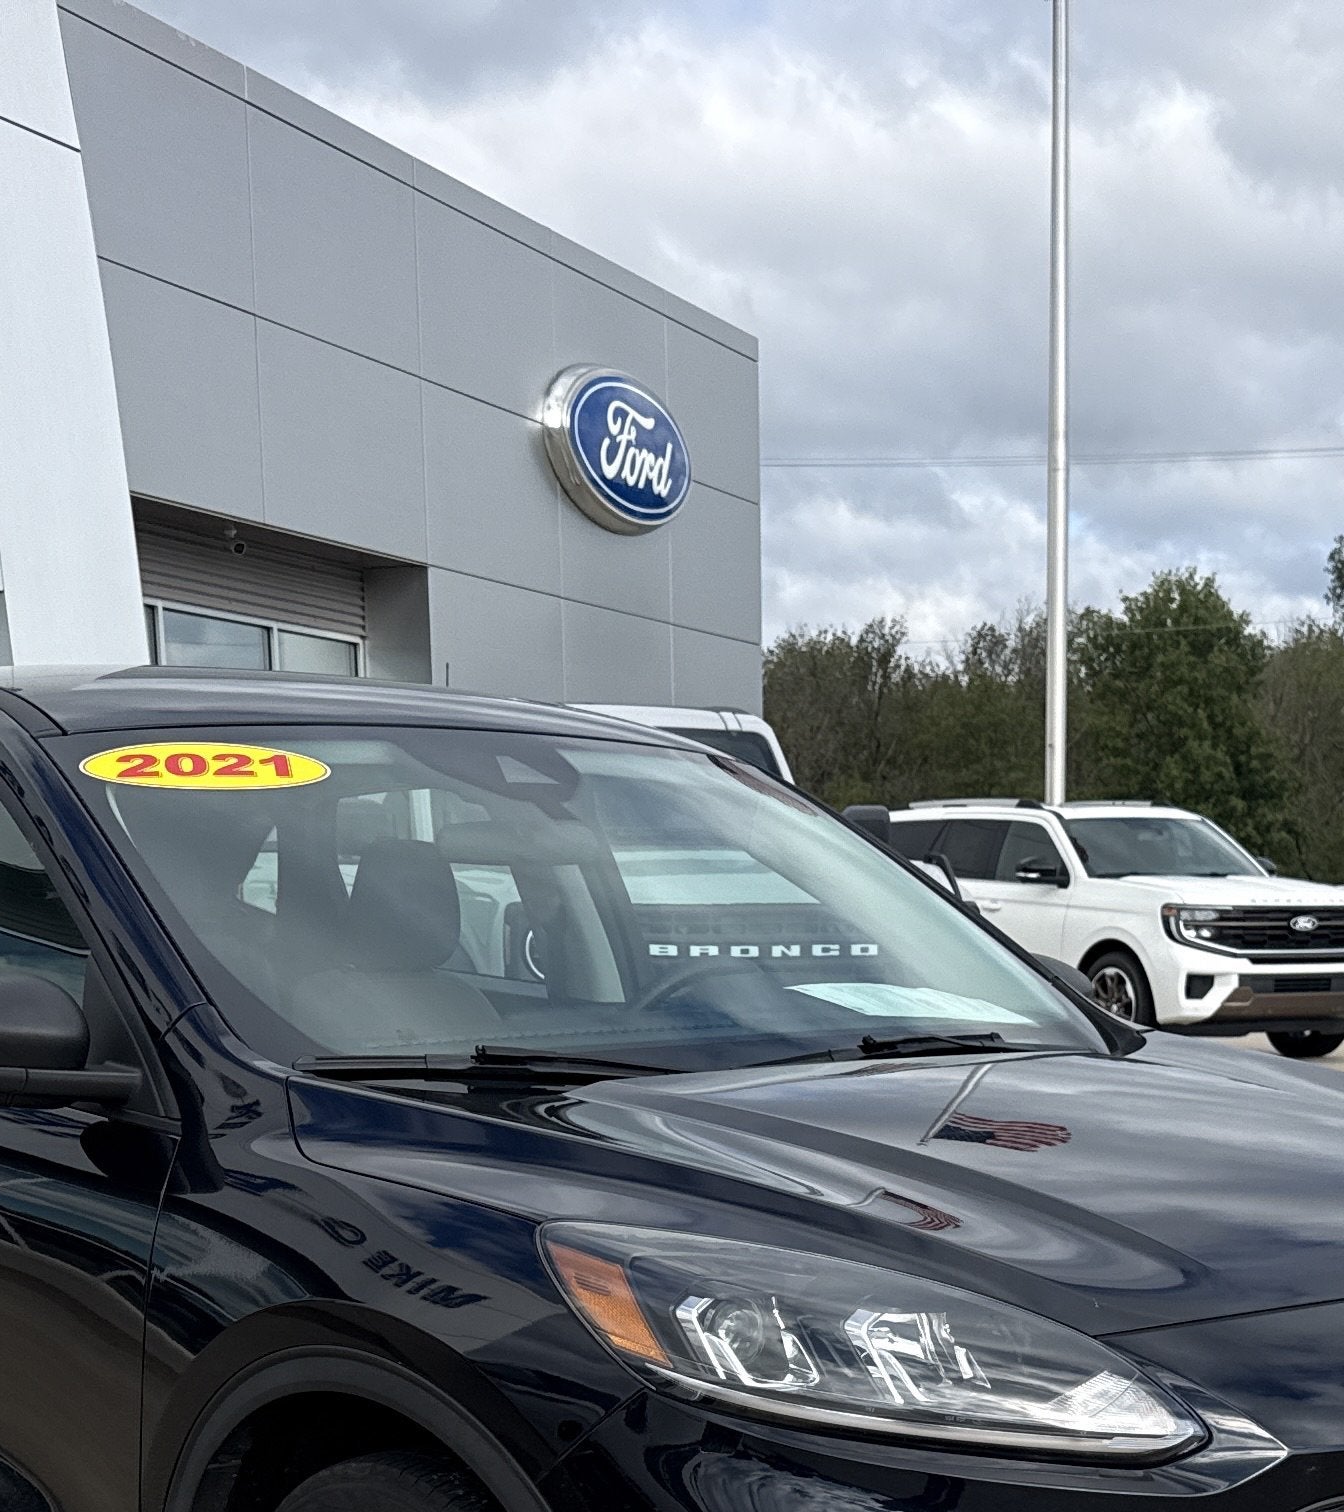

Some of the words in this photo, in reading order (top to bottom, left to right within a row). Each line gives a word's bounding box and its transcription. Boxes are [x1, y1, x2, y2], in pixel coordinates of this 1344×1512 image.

[600, 400, 672, 498] Ford
[116, 753, 293, 778] 2021
[649, 943, 879, 958] BRONCO
